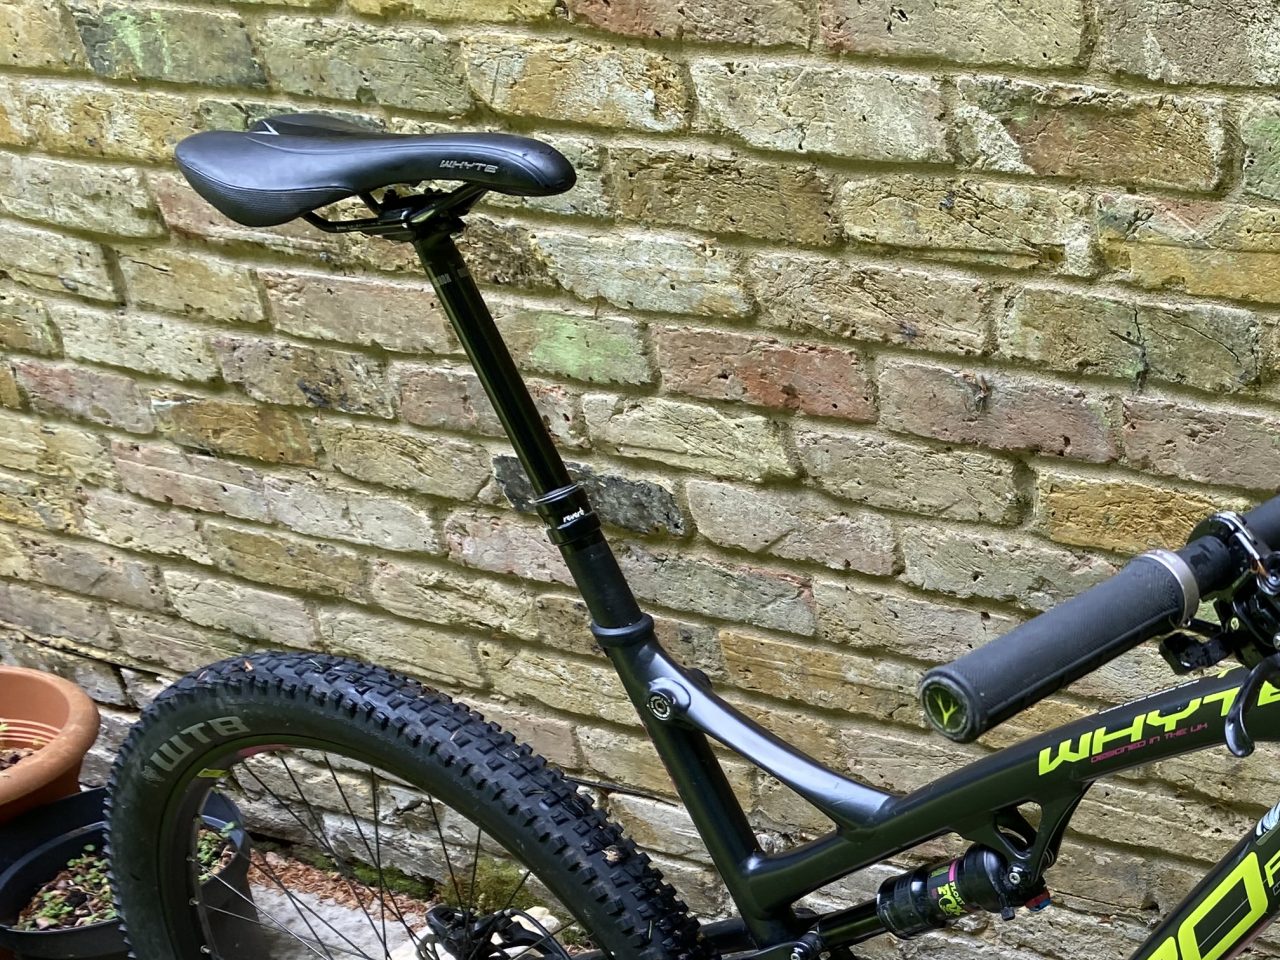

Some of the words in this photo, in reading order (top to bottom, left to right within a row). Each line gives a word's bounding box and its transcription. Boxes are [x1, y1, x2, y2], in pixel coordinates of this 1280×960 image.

[439, 160, 499, 174] WHYTE
[150, 716, 251, 772] WTB
[1090, 739, 1147, 764] DESIGNED
[1148, 735, 1161, 745] IN
[1164, 727, 1188, 740] THE
